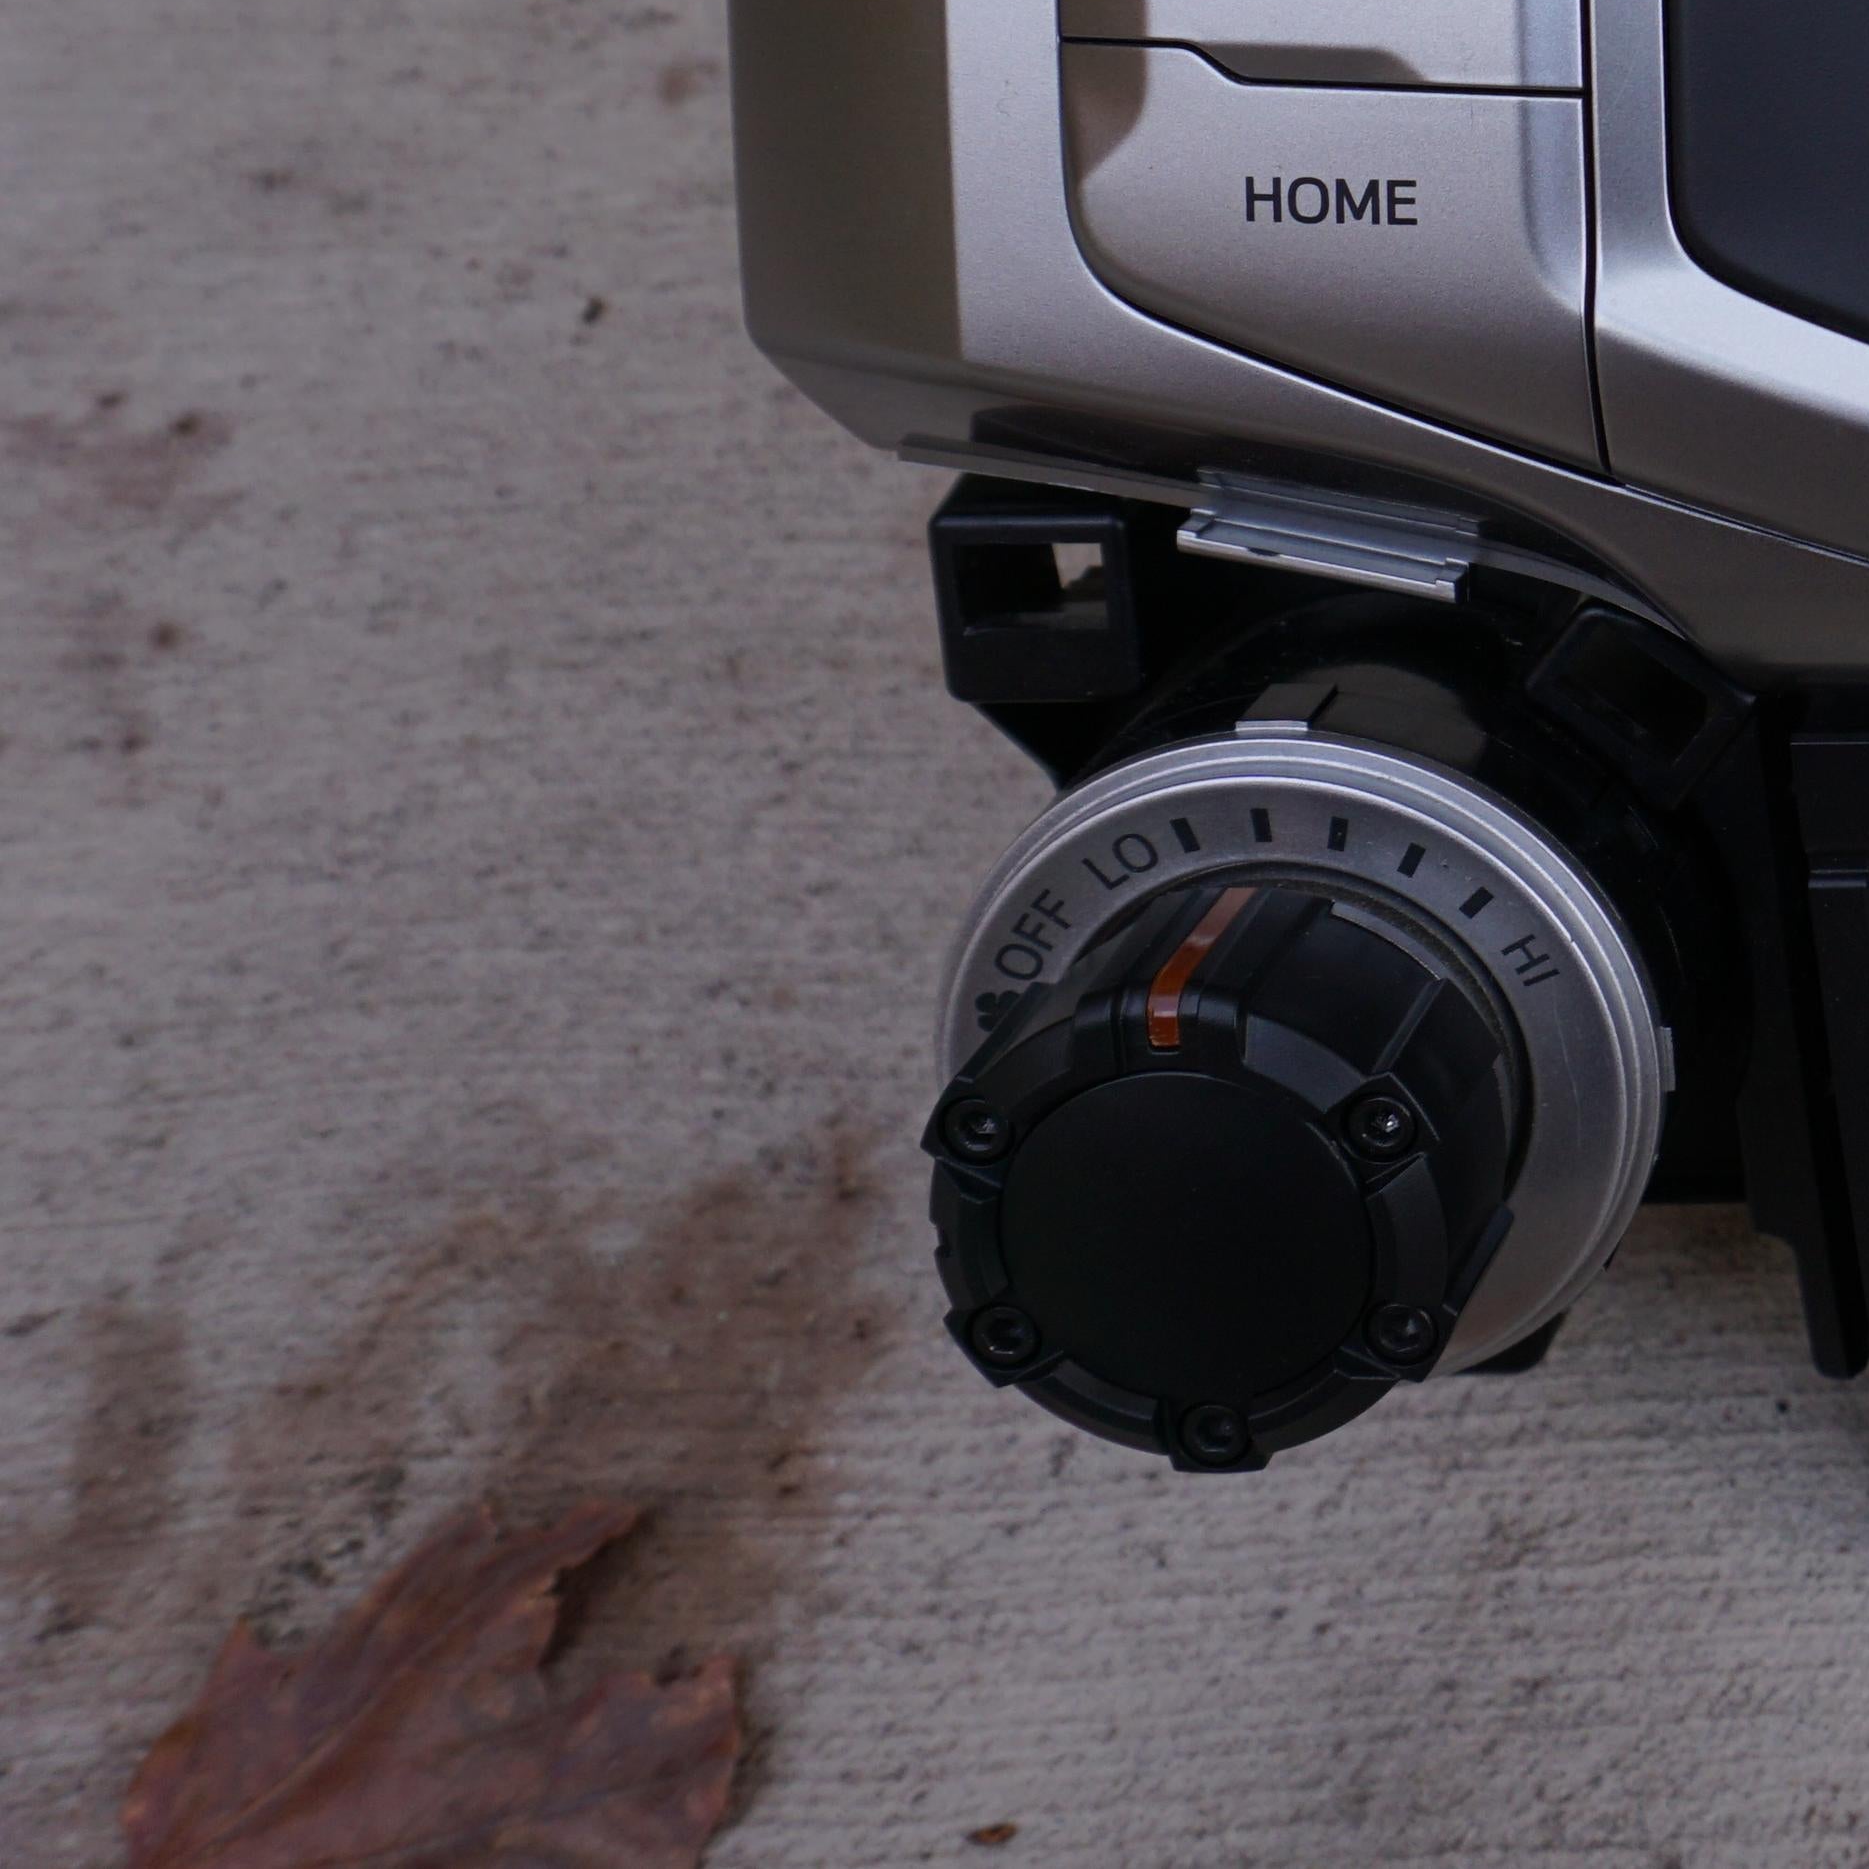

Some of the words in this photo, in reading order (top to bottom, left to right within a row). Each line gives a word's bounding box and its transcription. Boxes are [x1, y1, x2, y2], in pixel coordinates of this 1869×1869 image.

[1244, 176, 1419, 226] HOME
[1080, 833, 1159, 890] LO
[995, 889, 1073, 981] OFF
[1500, 933, 1561, 988] HI
